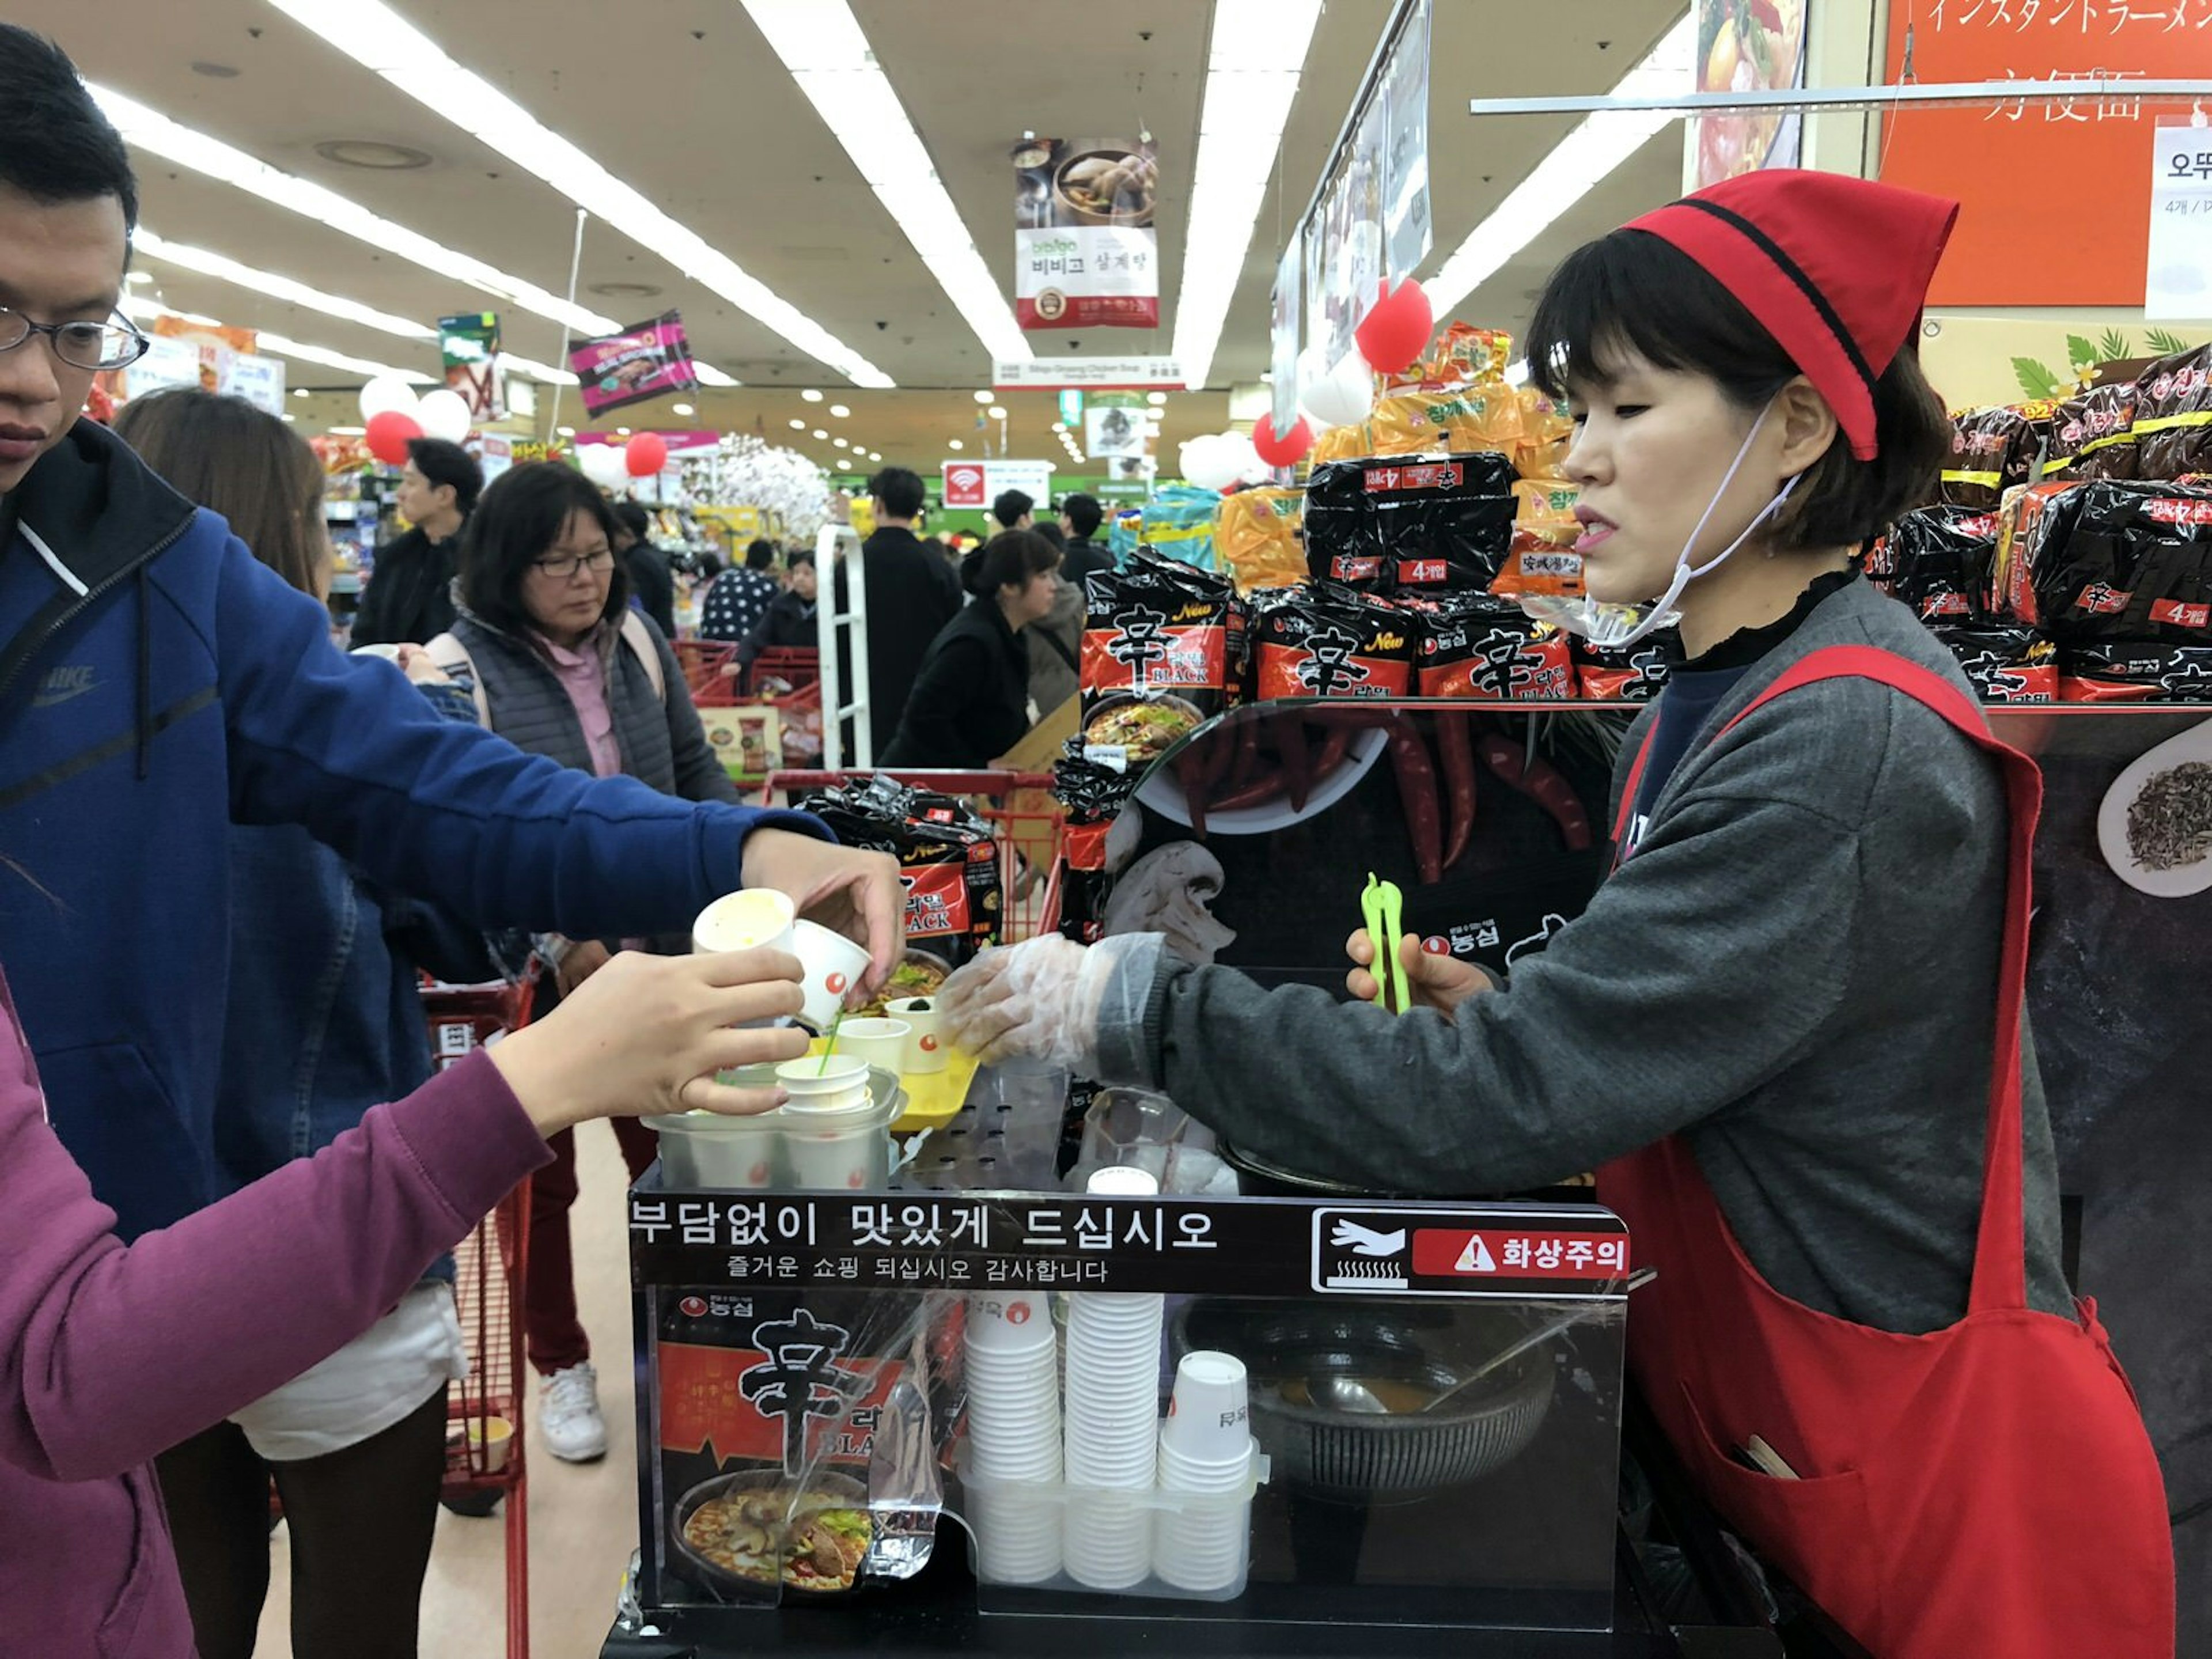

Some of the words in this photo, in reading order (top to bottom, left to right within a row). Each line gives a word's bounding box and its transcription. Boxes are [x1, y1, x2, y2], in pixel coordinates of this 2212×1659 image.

[1032, 257, 1084, 275] 비비고
[1412, 560, 1446, 581] 4개입
[1172, 603, 1212, 622] New
[1107, 603, 1182, 699] 辛
[1364, 631, 1404, 653] New
[1295, 626, 1371, 696] 辛
[1469, 628, 1546, 698] 辛
[48, 666, 94, 689] NIKE
[1152, 666, 1209, 684] BLACK
[906, 912, 952, 932] ACK
[1450, 926, 1500, 954] 농심
[630, 1200, 816, 1246] 부담없이
[851, 1202, 988, 1249] 맛있게
[1022, 1207, 1218, 1251] 드십시오
[1502, 1238, 1624, 1271] 화상주의
[727, 1255, 799, 1278] 즐거운
[813, 1257, 859, 1279] 쇼핑
[874, 1257, 971, 1281] 되십시오
[986, 1259, 1108, 1283] 감사합니다
[709, 1301, 753, 1317] 농심
[738, 1308, 876, 1479] 辛
[851, 1404, 884, 1431] 라
